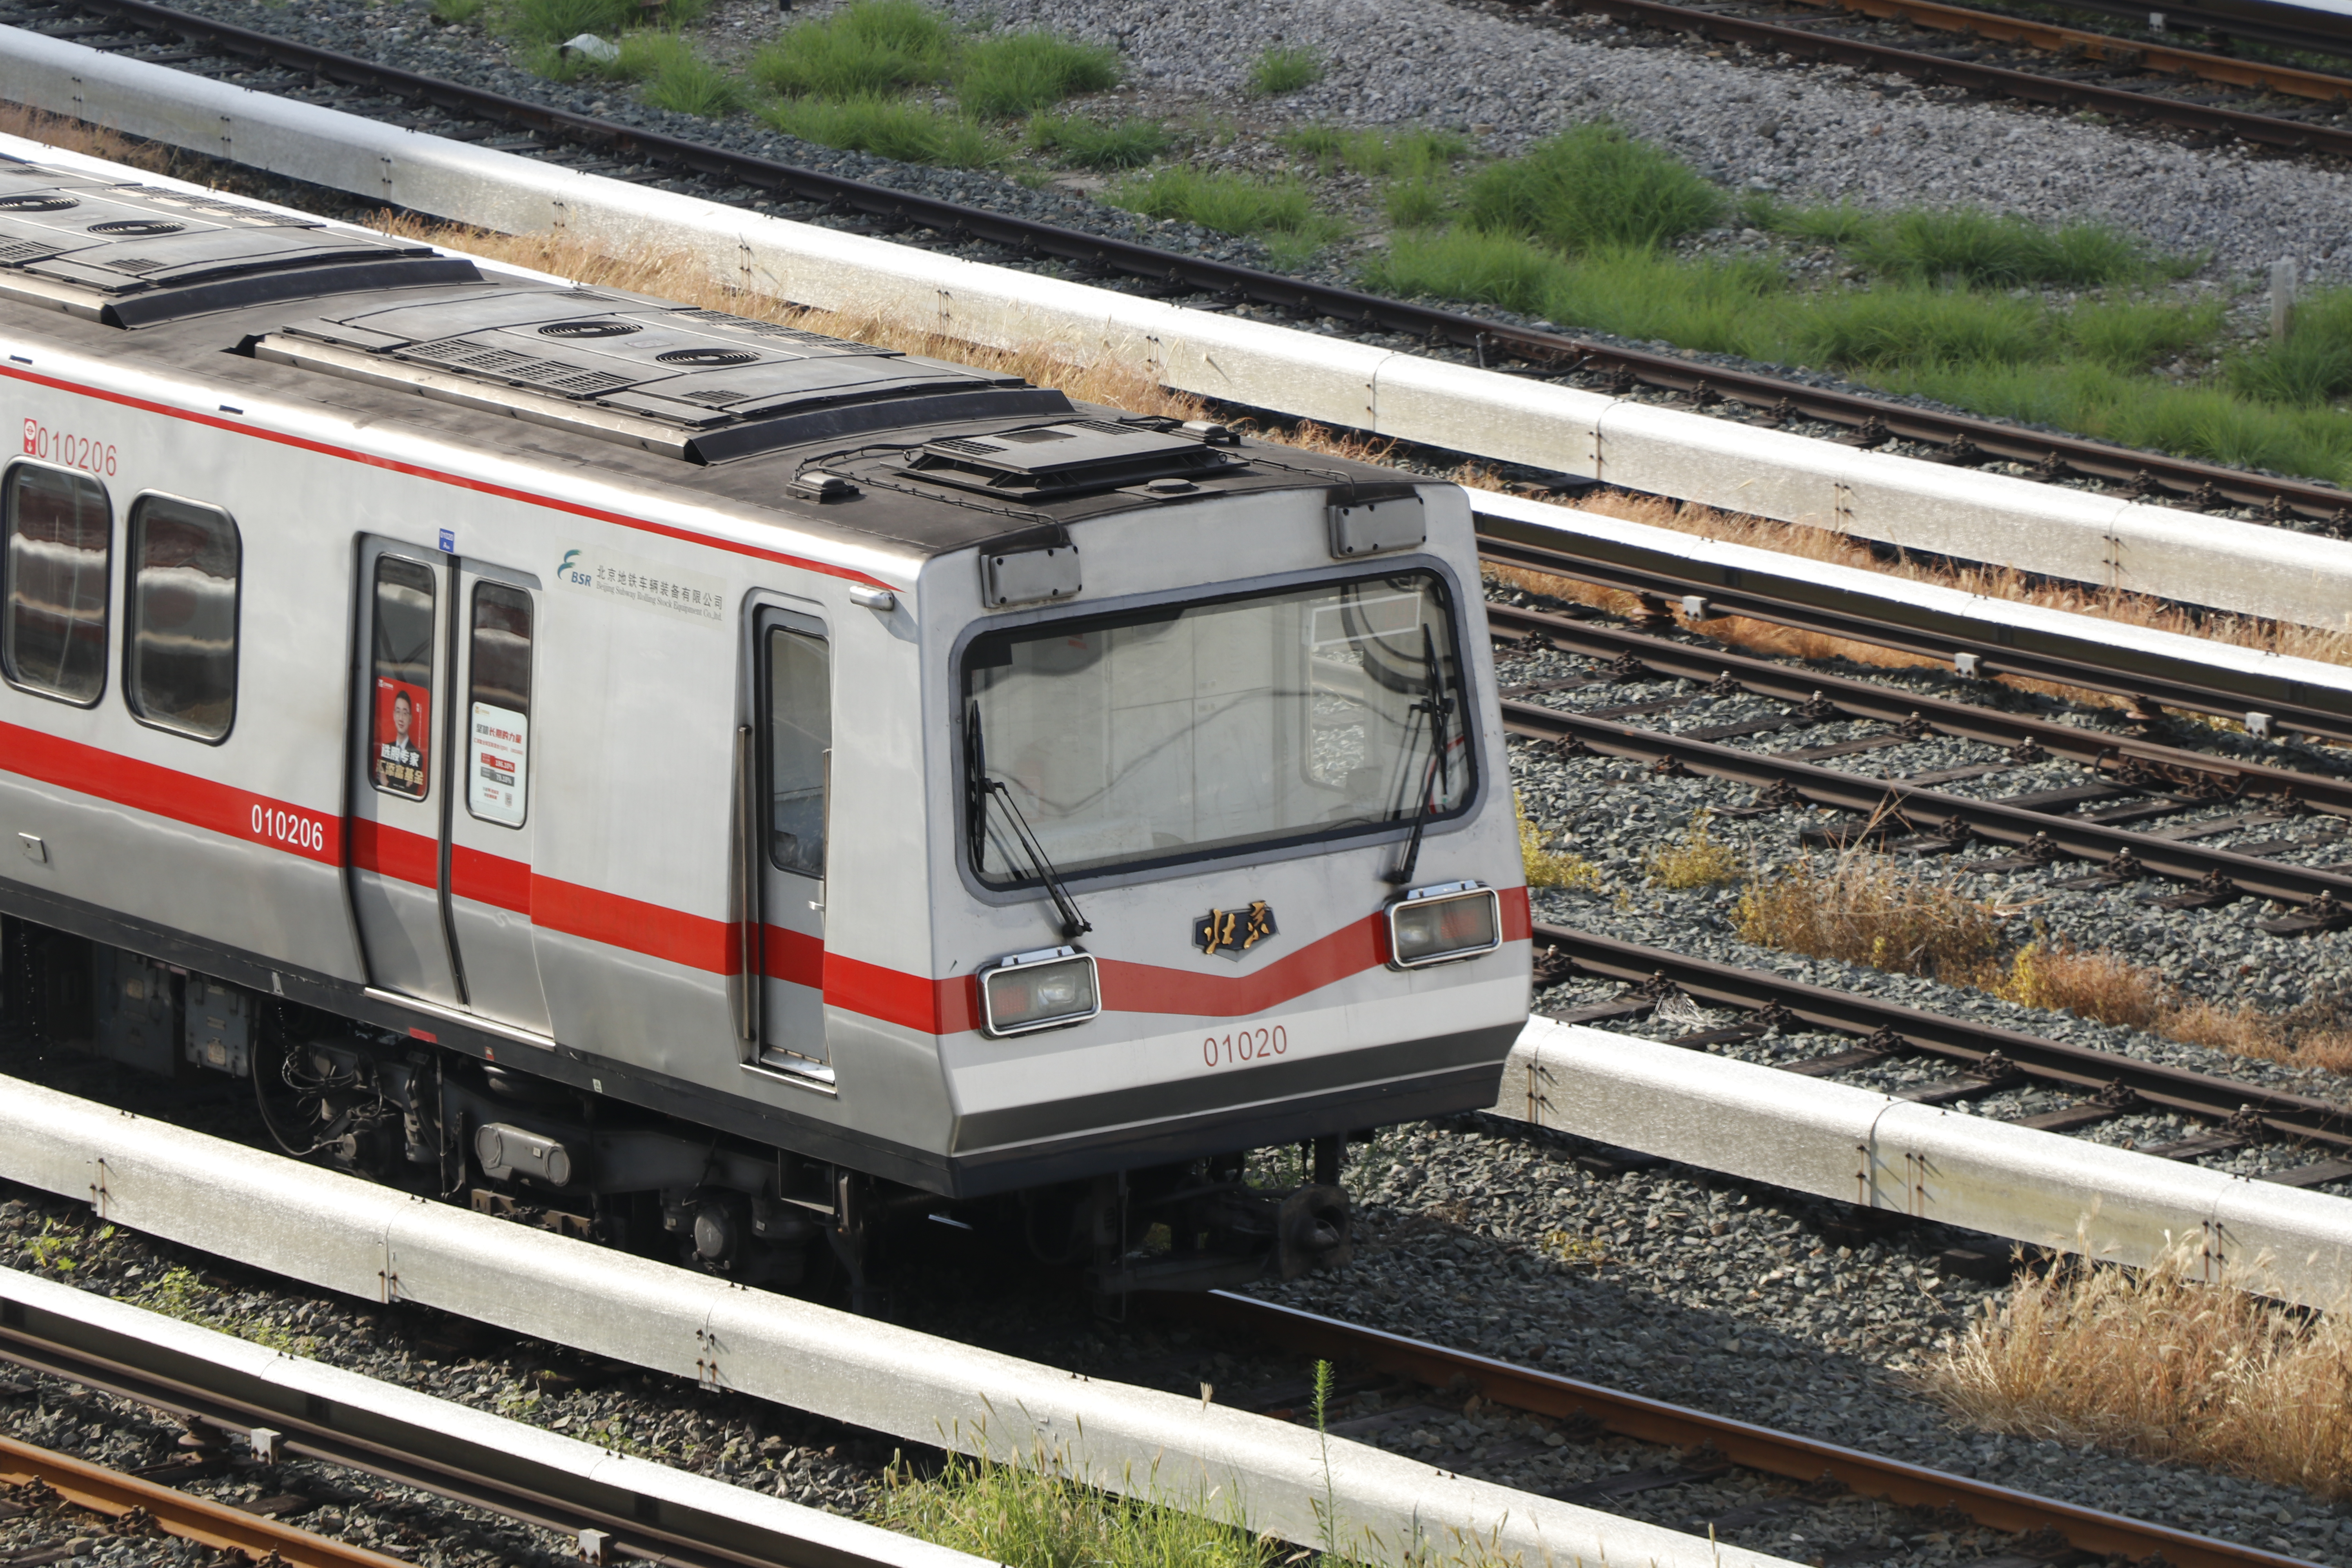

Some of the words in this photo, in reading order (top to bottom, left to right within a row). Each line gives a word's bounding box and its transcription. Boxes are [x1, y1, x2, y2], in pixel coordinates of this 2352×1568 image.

[38, 427, 116, 476] 010206
[572, 572, 592, 587] BSR
[596, 581, 615, 595] Beijing
[615, 586, 636, 600] Subway
[637, 592, 656, 606] Rolling
[657, 597, 672, 608] Stock
[673, 601, 702, 616] Equipment
[597, 565, 722, 610] 北京地铁车辆装备有限公司
[376, 759, 423, 785] 汇添富基金
[381, 743, 420, 767] 选股专家
[252, 804, 323, 851] 010206
[1203, 901, 1270, 955] 北京
[1203, 1025, 1287, 1067] 01020
